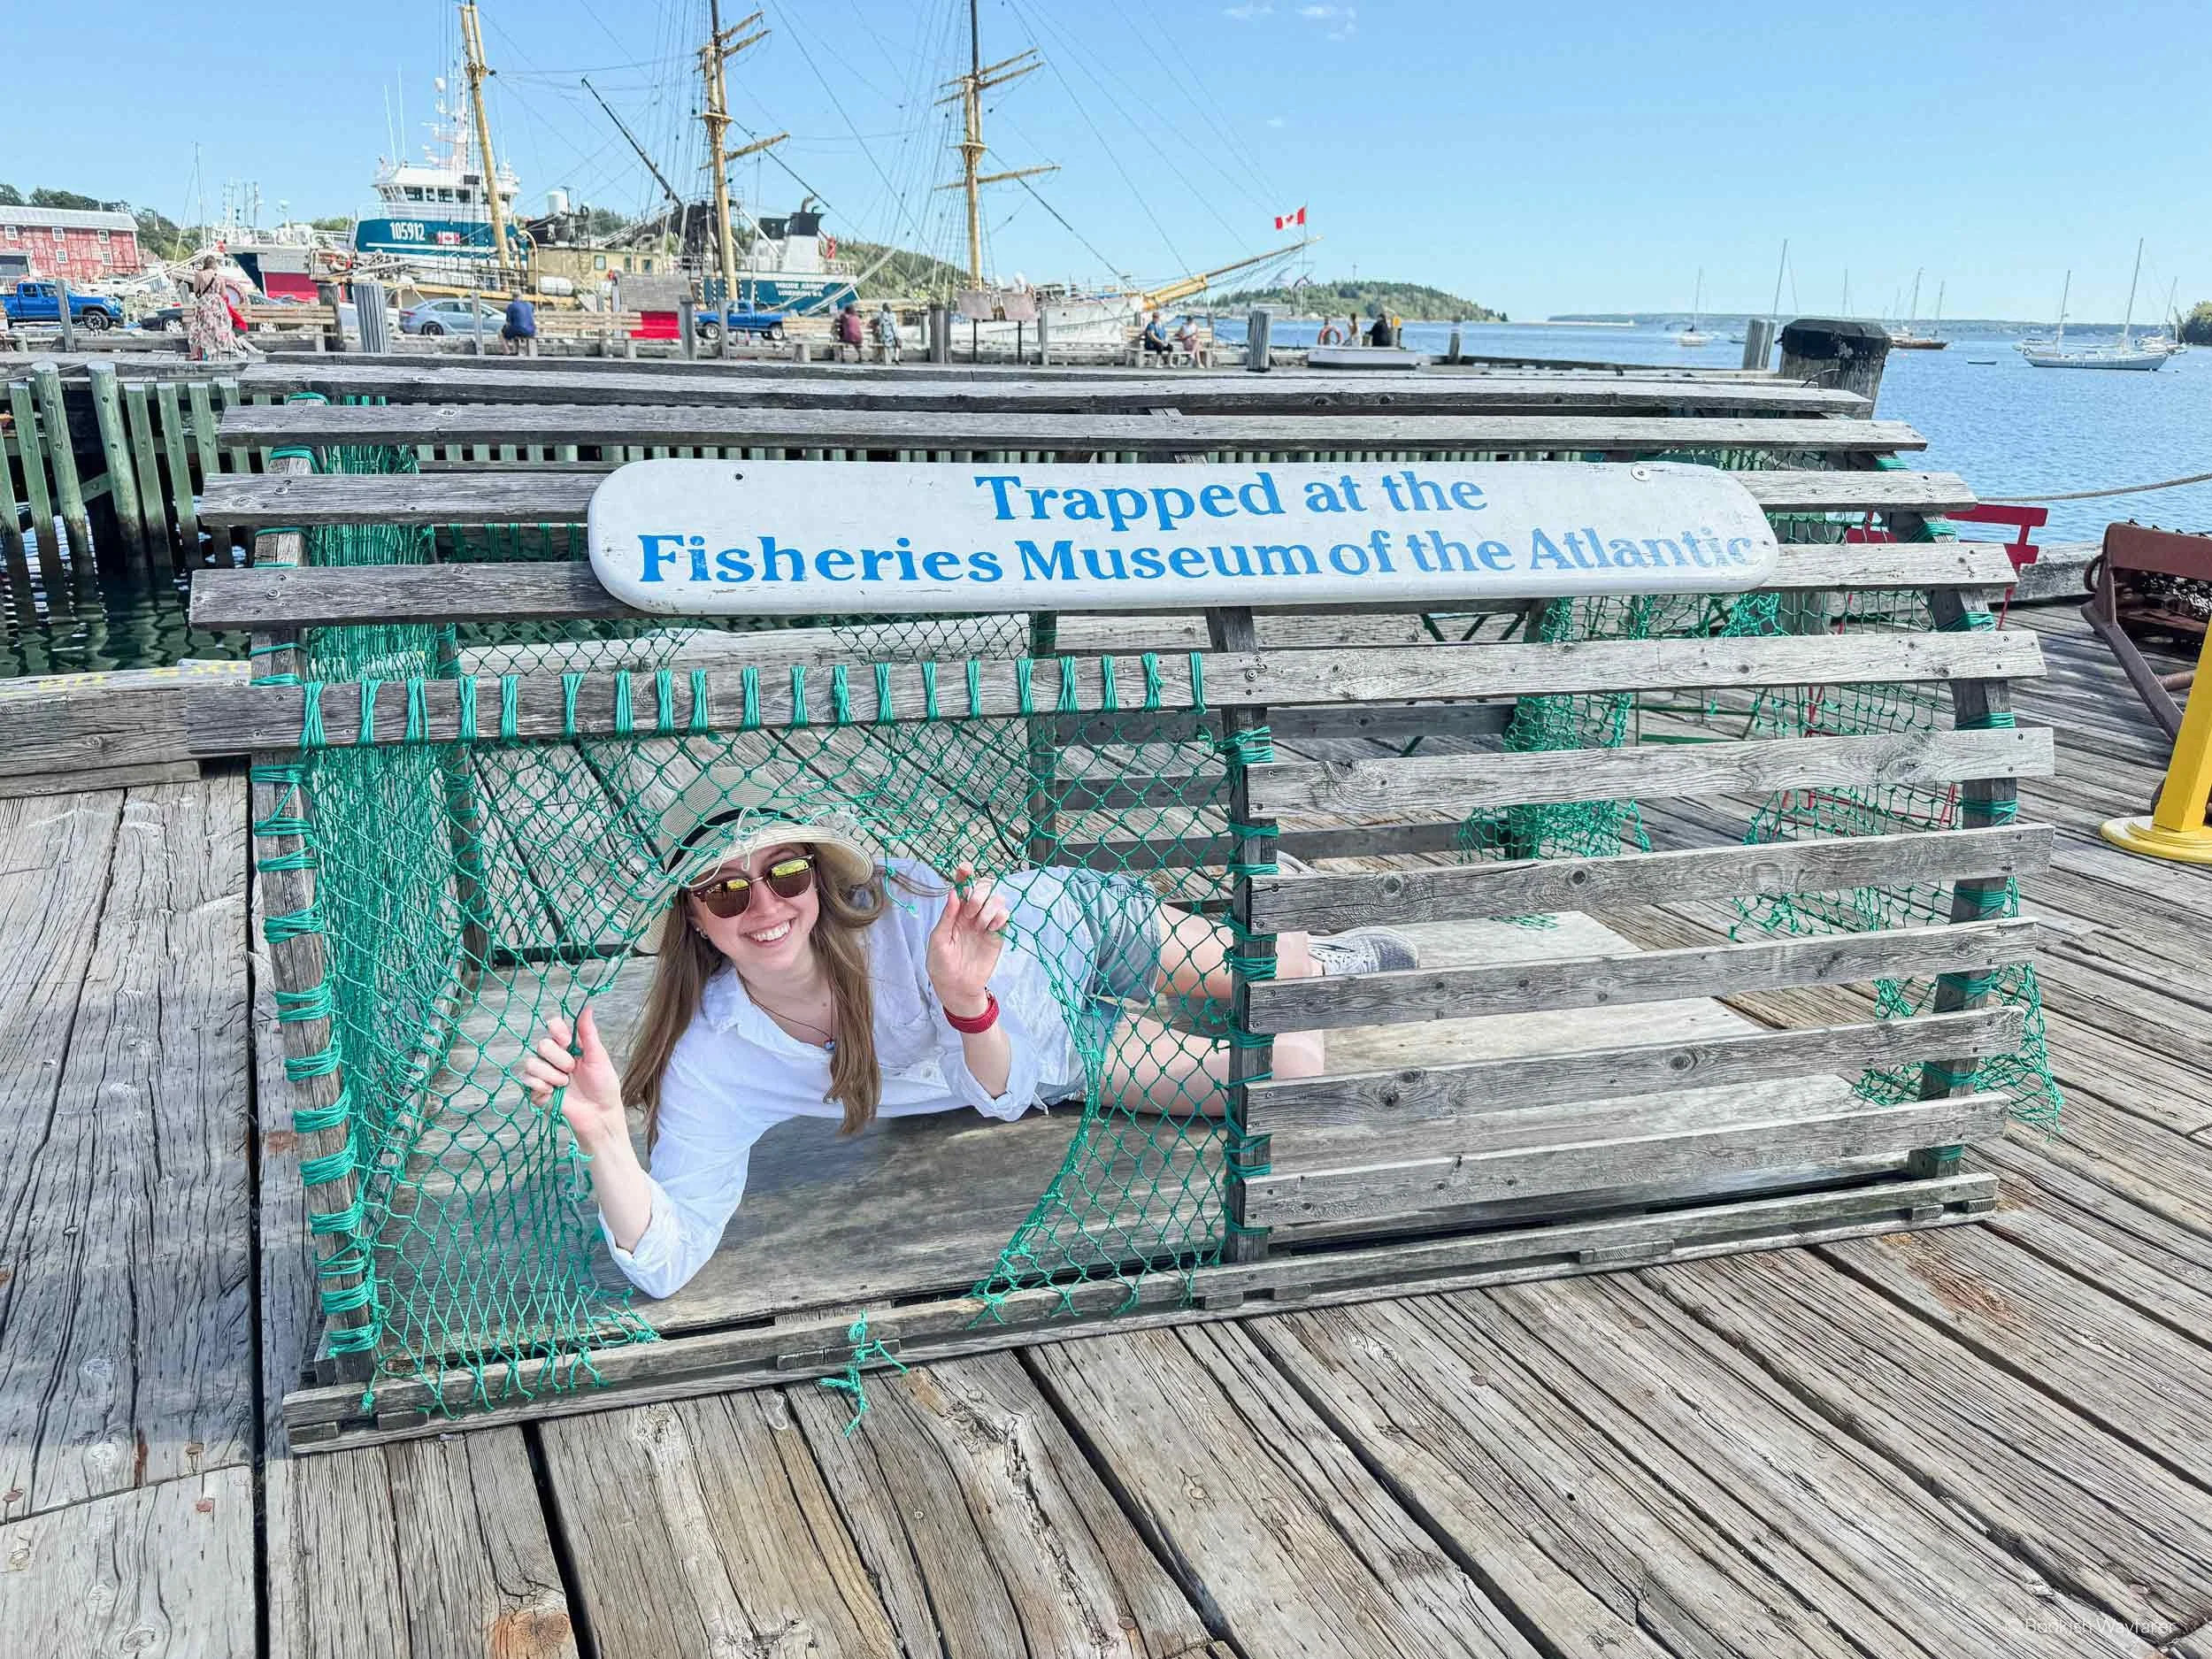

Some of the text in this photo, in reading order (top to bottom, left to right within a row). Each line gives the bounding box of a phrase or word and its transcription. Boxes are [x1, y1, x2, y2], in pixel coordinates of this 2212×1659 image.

[389, 221, 425, 241] 105912
[973, 470, 1486, 534] Trapped at the
[636, 526, 1754, 584] Fisheries Museum of the Atlantic
